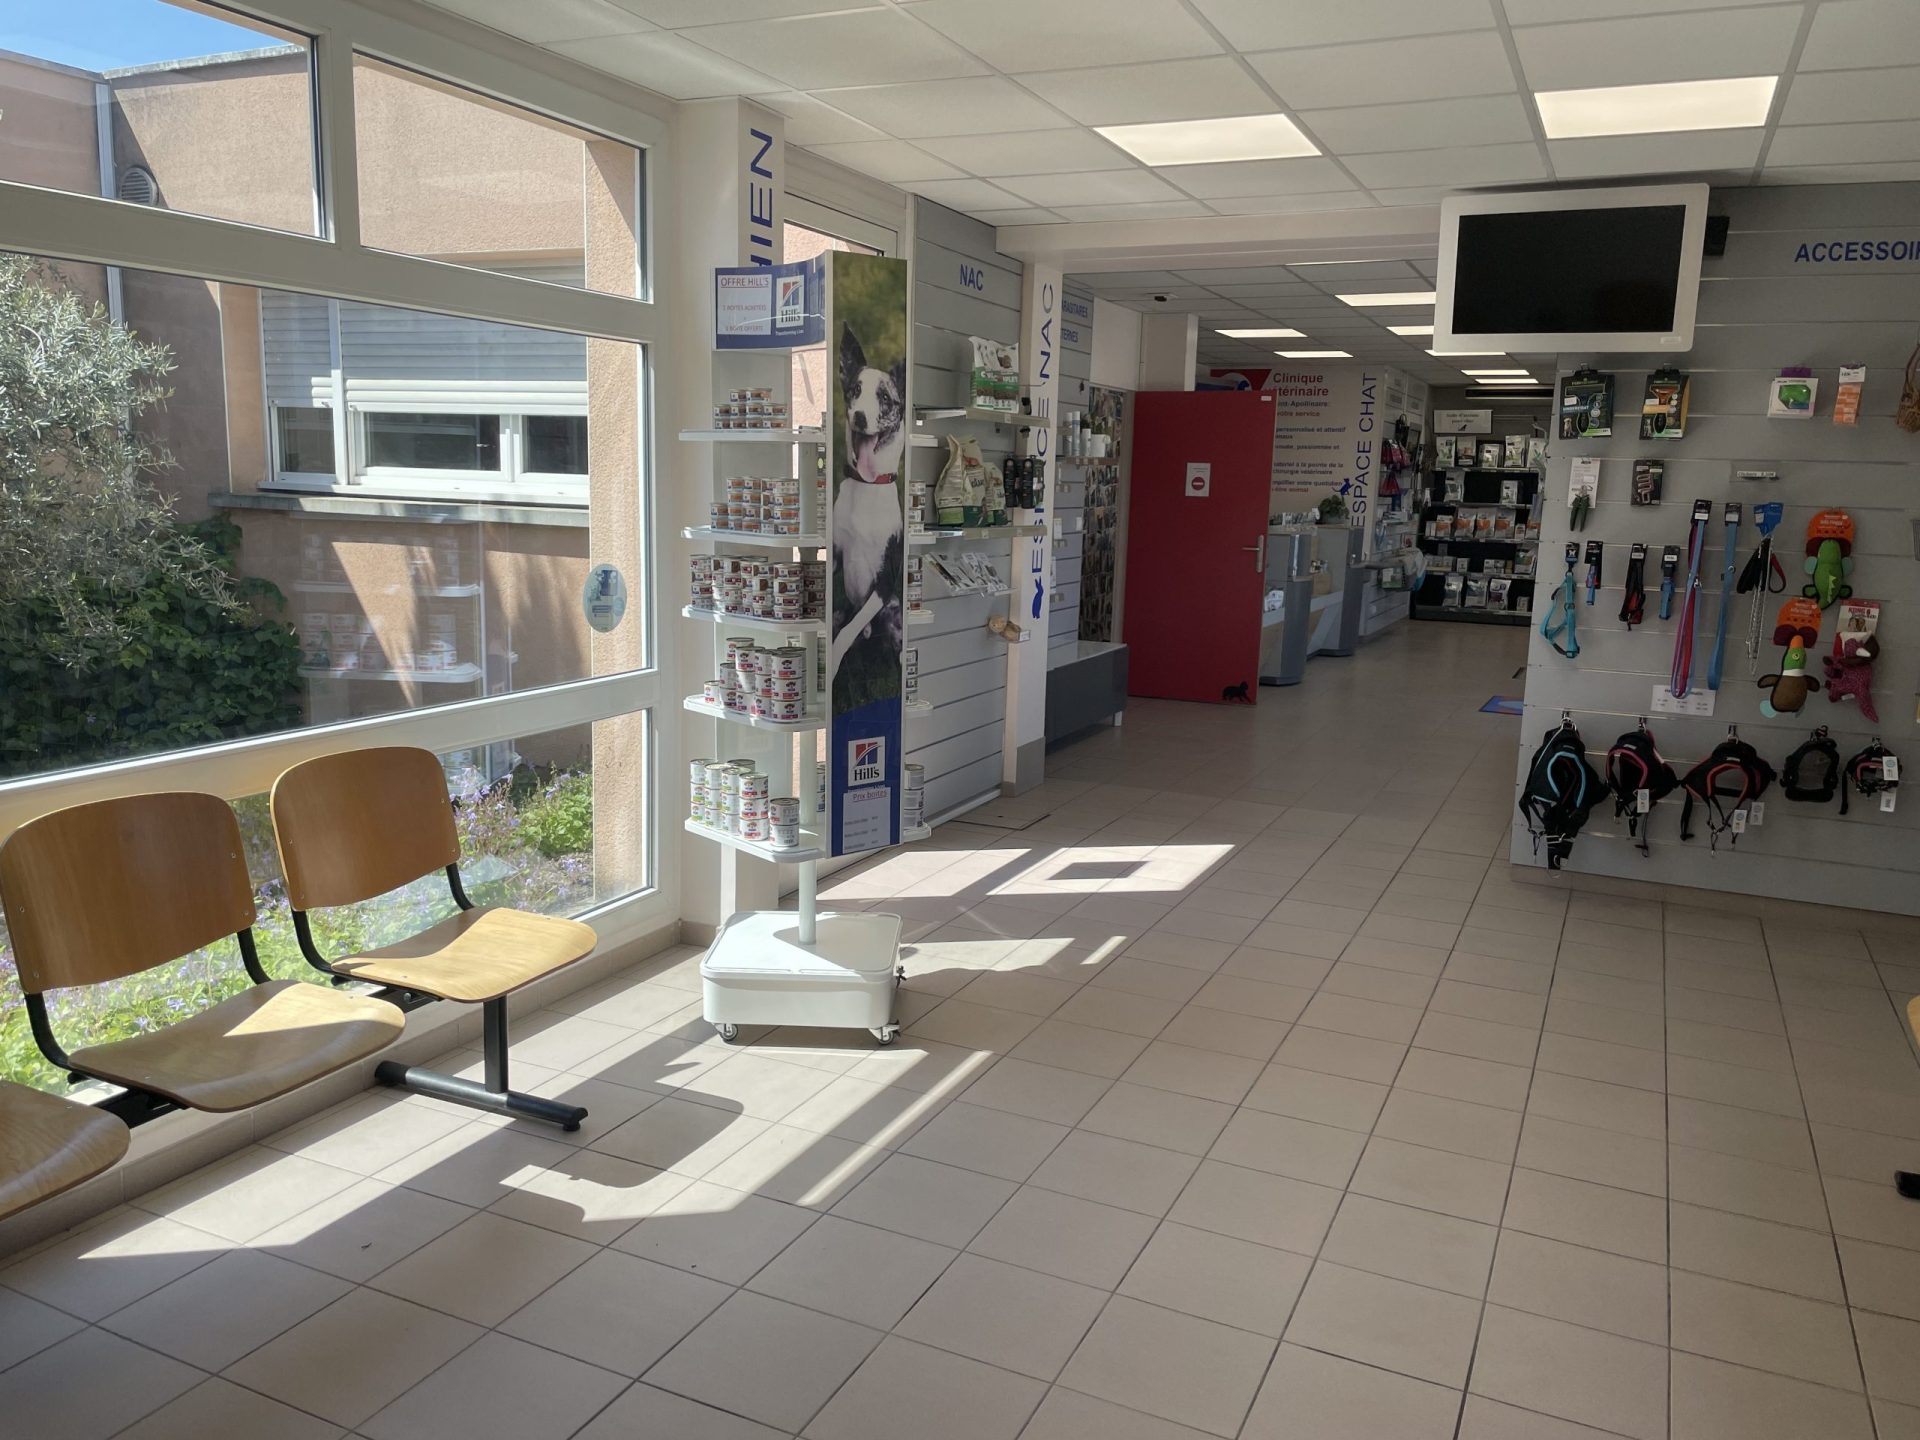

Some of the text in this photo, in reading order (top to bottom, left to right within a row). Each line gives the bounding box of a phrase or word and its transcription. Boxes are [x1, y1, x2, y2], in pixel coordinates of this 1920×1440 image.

[750, 128, 773, 267] IEN
[721, 277, 745, 287] OFFRE
[959, 263, 984, 292] NAC
[1273, 372, 1324, 385] Clinique
[1278, 386, 1329, 397] térinaire
[1031, 283, 1054, 573] ESCE NAC
[1352, 373, 1377, 528] ESPACE CHAT
[854, 766, 880, 781] Hill's
